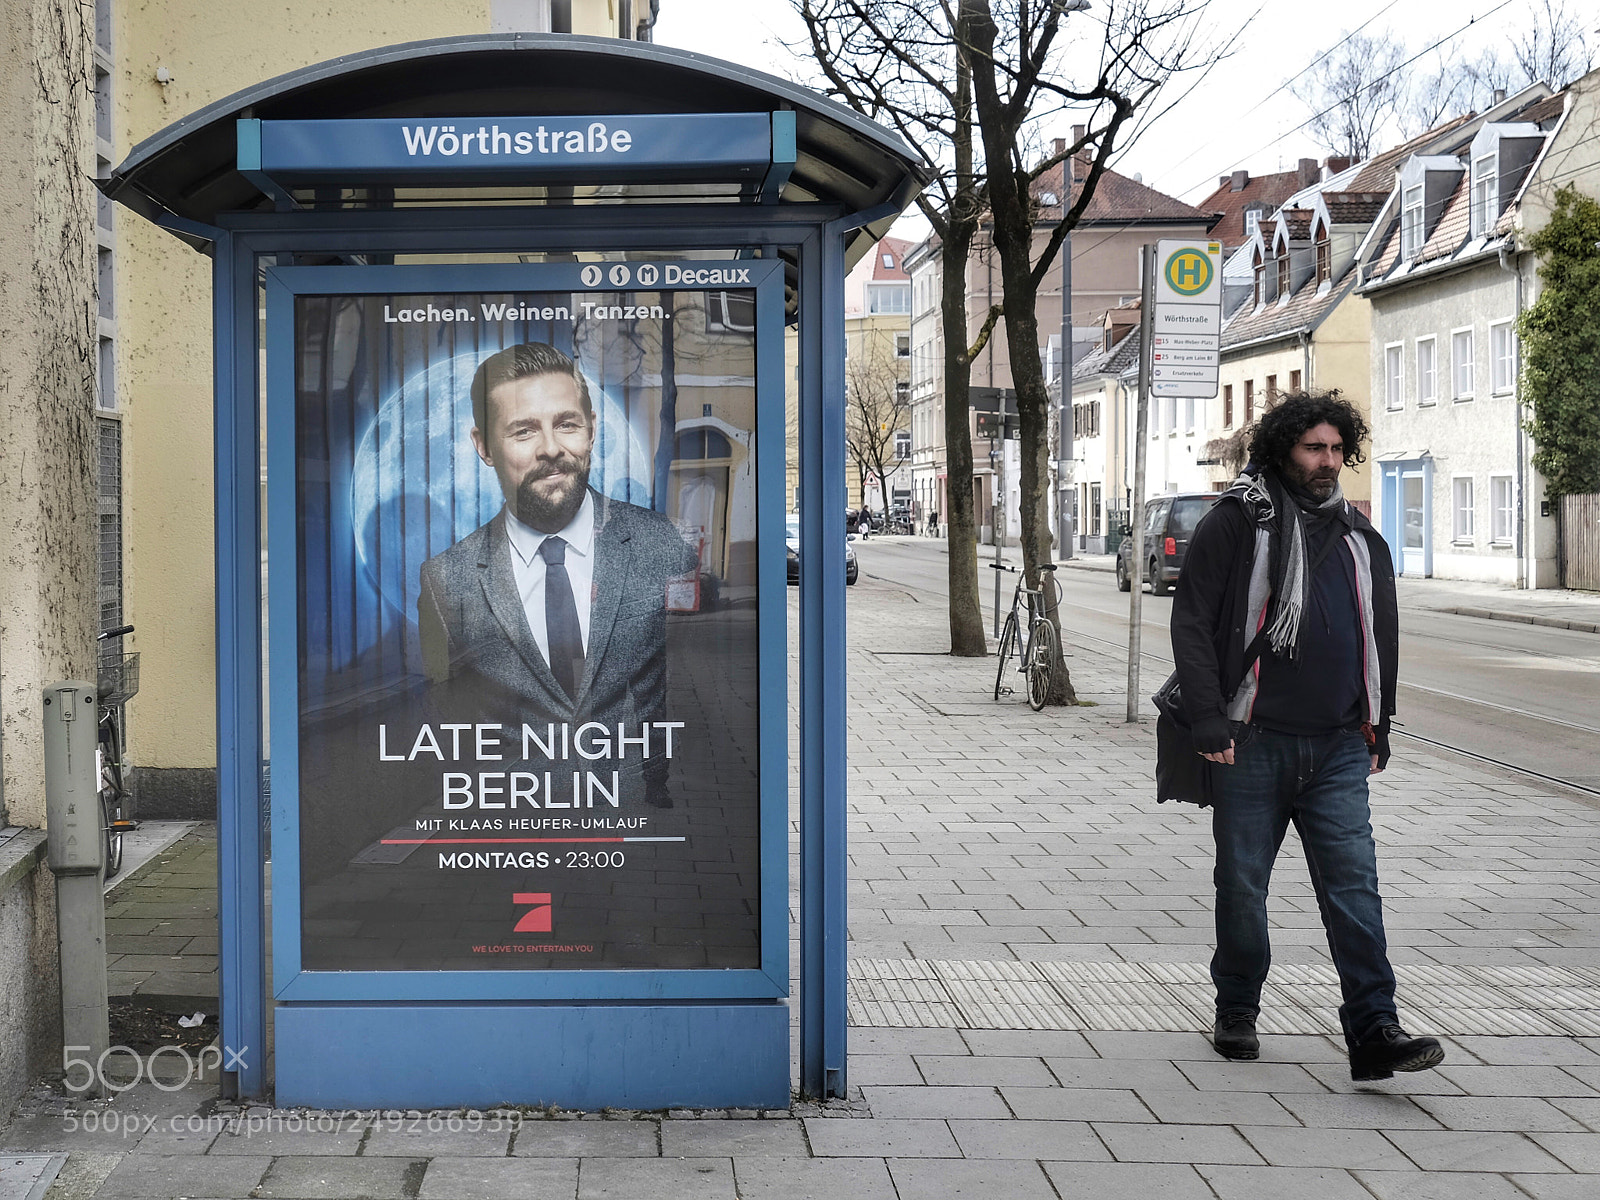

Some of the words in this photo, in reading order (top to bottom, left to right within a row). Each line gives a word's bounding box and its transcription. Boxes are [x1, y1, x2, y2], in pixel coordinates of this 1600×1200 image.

[402, 121, 634, 158] Wörthstraße
[665, 265, 750, 285] Decaux
[383, 303, 476, 325] Lachen.
[481, 301, 575, 323] Weinen.
[580, 301, 672, 321] Tanzen.
[1164, 314, 1209, 324] Wörthstraße
[379, 723, 503, 761] LATE
[522, 721, 686, 760] NIGHT
[442, 770, 620, 810] BERLIN
[415, 819, 443, 831] MIT
[449, 818, 503, 830] KLAAS
[508, 817, 649, 830] HEUFER-UMLAUF
[438, 852, 549, 869] MONTAGS
[566, 851, 625, 868] 23:00
[472, 945, 487, 953] WE
[488, 945, 512, 953] LOVE
[513, 945, 525, 953] TO
[526, 945, 574, 953] ENTERTAIN
[575, 945, 594, 953] YOU
